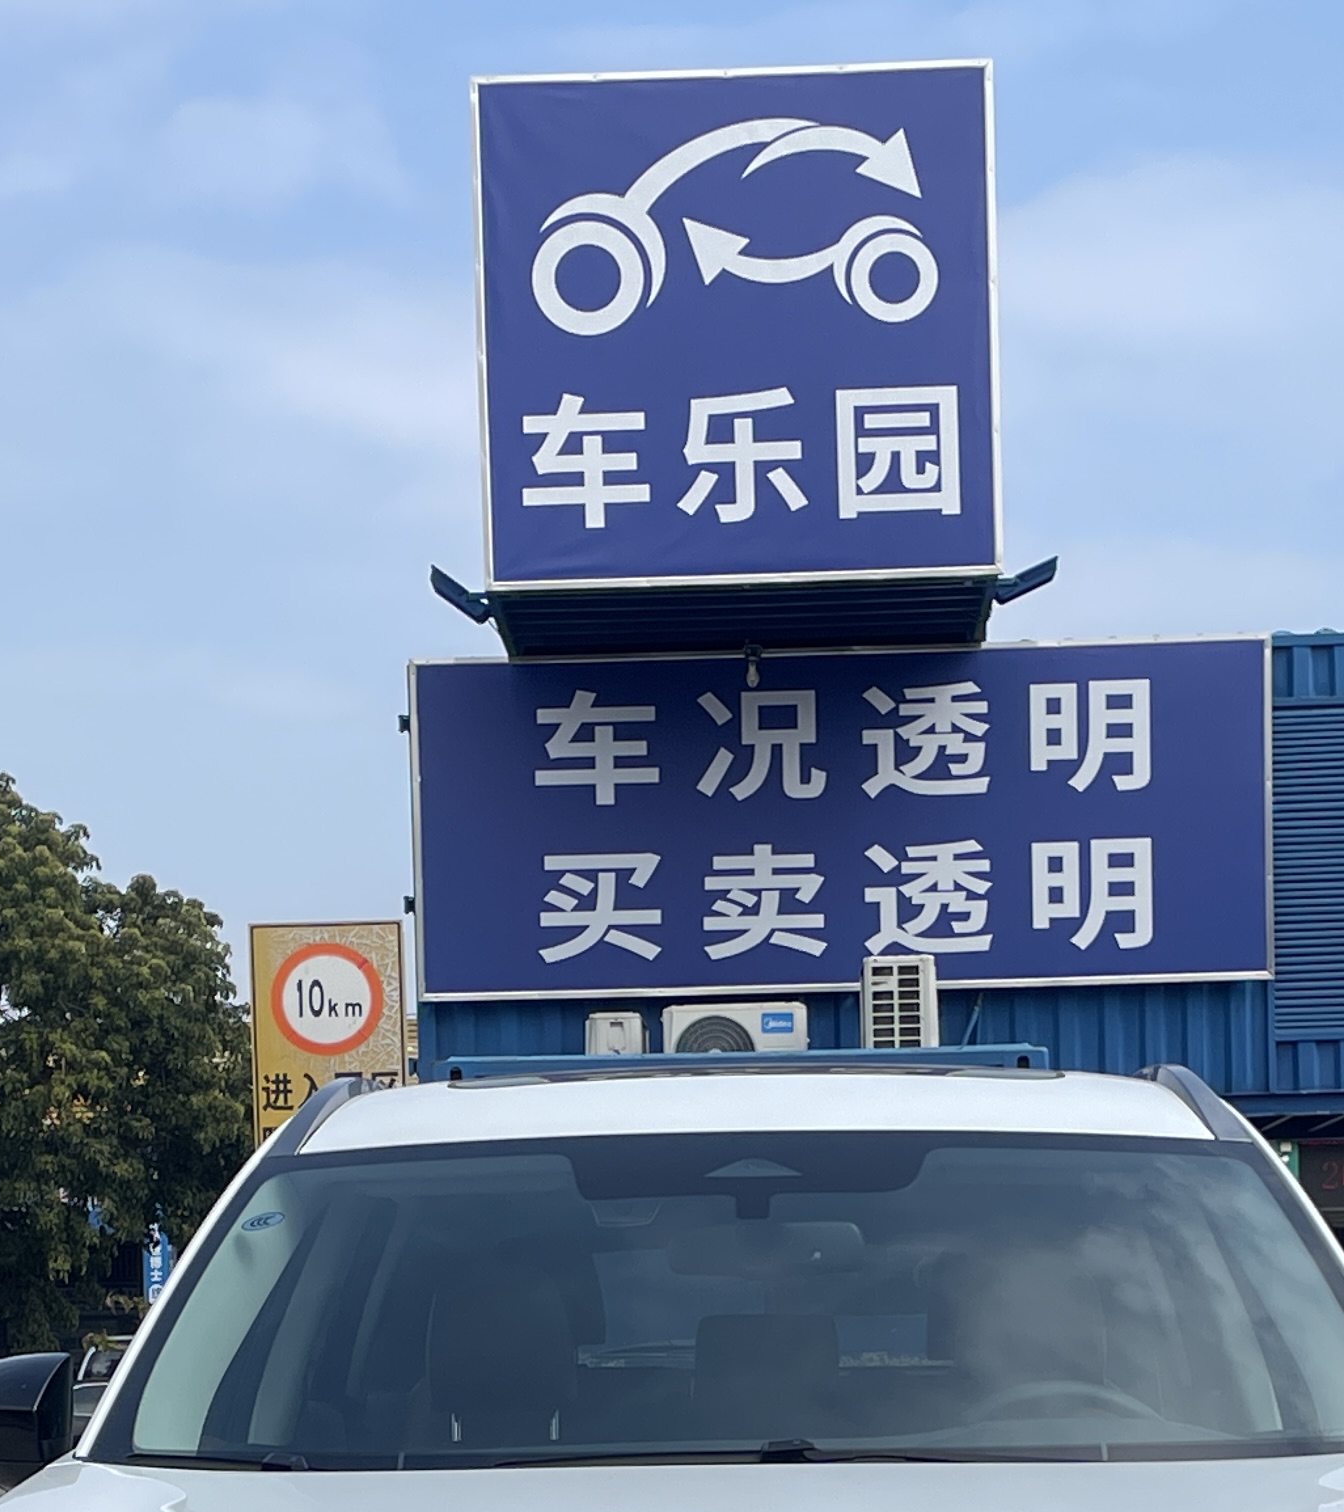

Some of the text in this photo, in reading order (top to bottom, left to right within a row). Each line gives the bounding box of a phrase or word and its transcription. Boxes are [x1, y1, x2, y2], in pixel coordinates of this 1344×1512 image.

[522, 385, 962, 529] 车乐园
[534, 678, 1152, 806] 车况透明
[538, 837, 1154, 964] 买卖透明
[296, 979, 363, 1019] 10km
